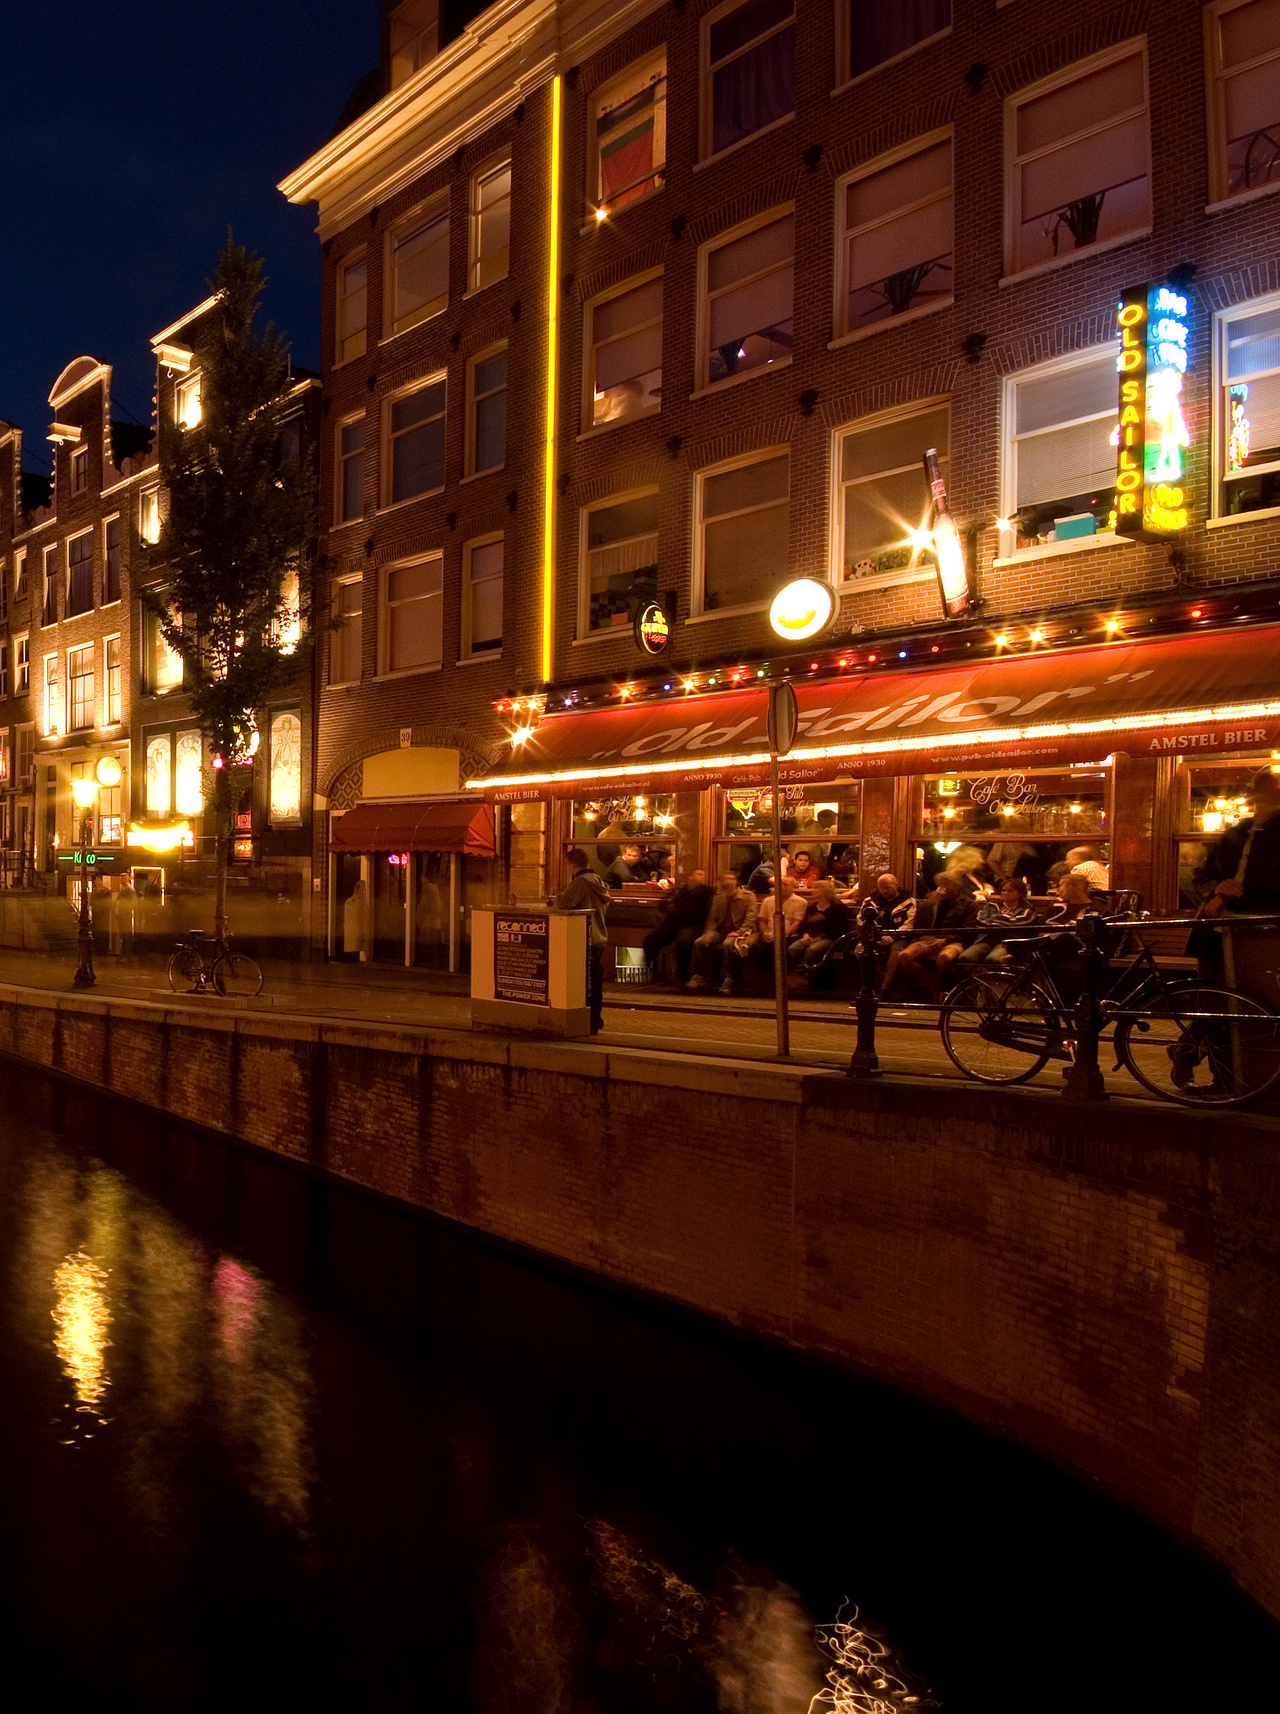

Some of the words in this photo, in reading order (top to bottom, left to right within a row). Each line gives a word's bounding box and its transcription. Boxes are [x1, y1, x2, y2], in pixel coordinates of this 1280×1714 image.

[1119, 304, 1144, 372] OLD
[1115, 381, 1140, 515] SAILOR
[401, 732, 410, 743] 39
[1149, 733, 1219, 750] AMSTEL
[1224, 729, 1268, 745] BIER
[931, 747, 1059, 763] www.pub-oldsailor.com
[837, 760, 863, 769] ANNO
[867, 759, 886, 767] 1930
[683, 774, 704, 782] ANNO
[494, 791, 522, 801] AMSTEL
[522, 789, 540, 799] BIER
[967, 774, 1001, 805] Café
[1003, 773, 1038, 800] Bar
[497, 921, 547, 933] reconnect
